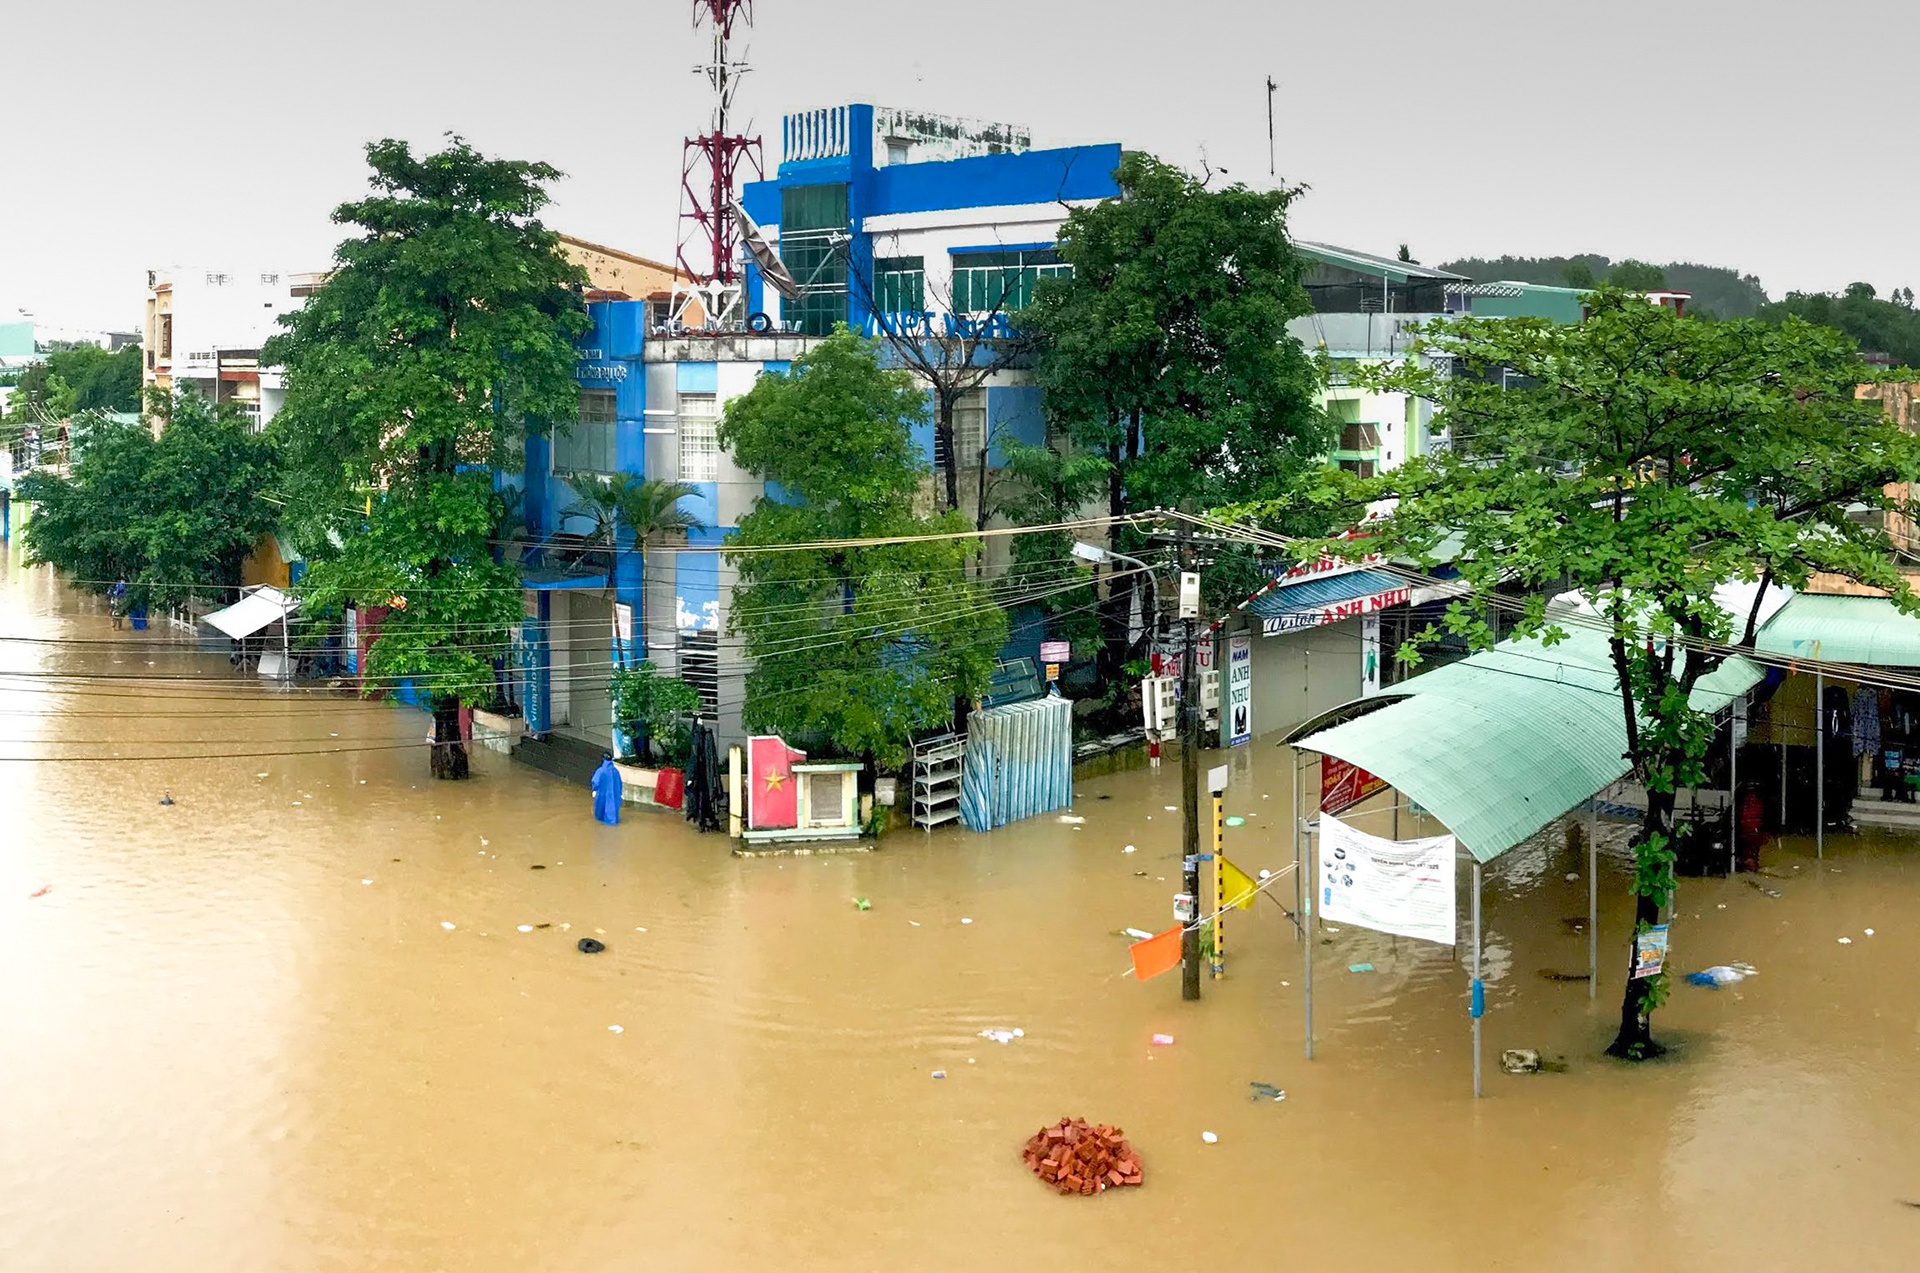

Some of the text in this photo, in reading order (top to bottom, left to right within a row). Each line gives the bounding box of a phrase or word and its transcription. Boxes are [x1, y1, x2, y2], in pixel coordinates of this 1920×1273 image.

[862, 311, 936, 339] VNPT
[1320, 599, 1364, 626] ANH
[1370, 581, 1412, 612] NHƯ
[1231, 648, 1249, 663] NAM
[1231, 665, 1250, 684] ANH
[1231, 683, 1250, 705] NHƯ
